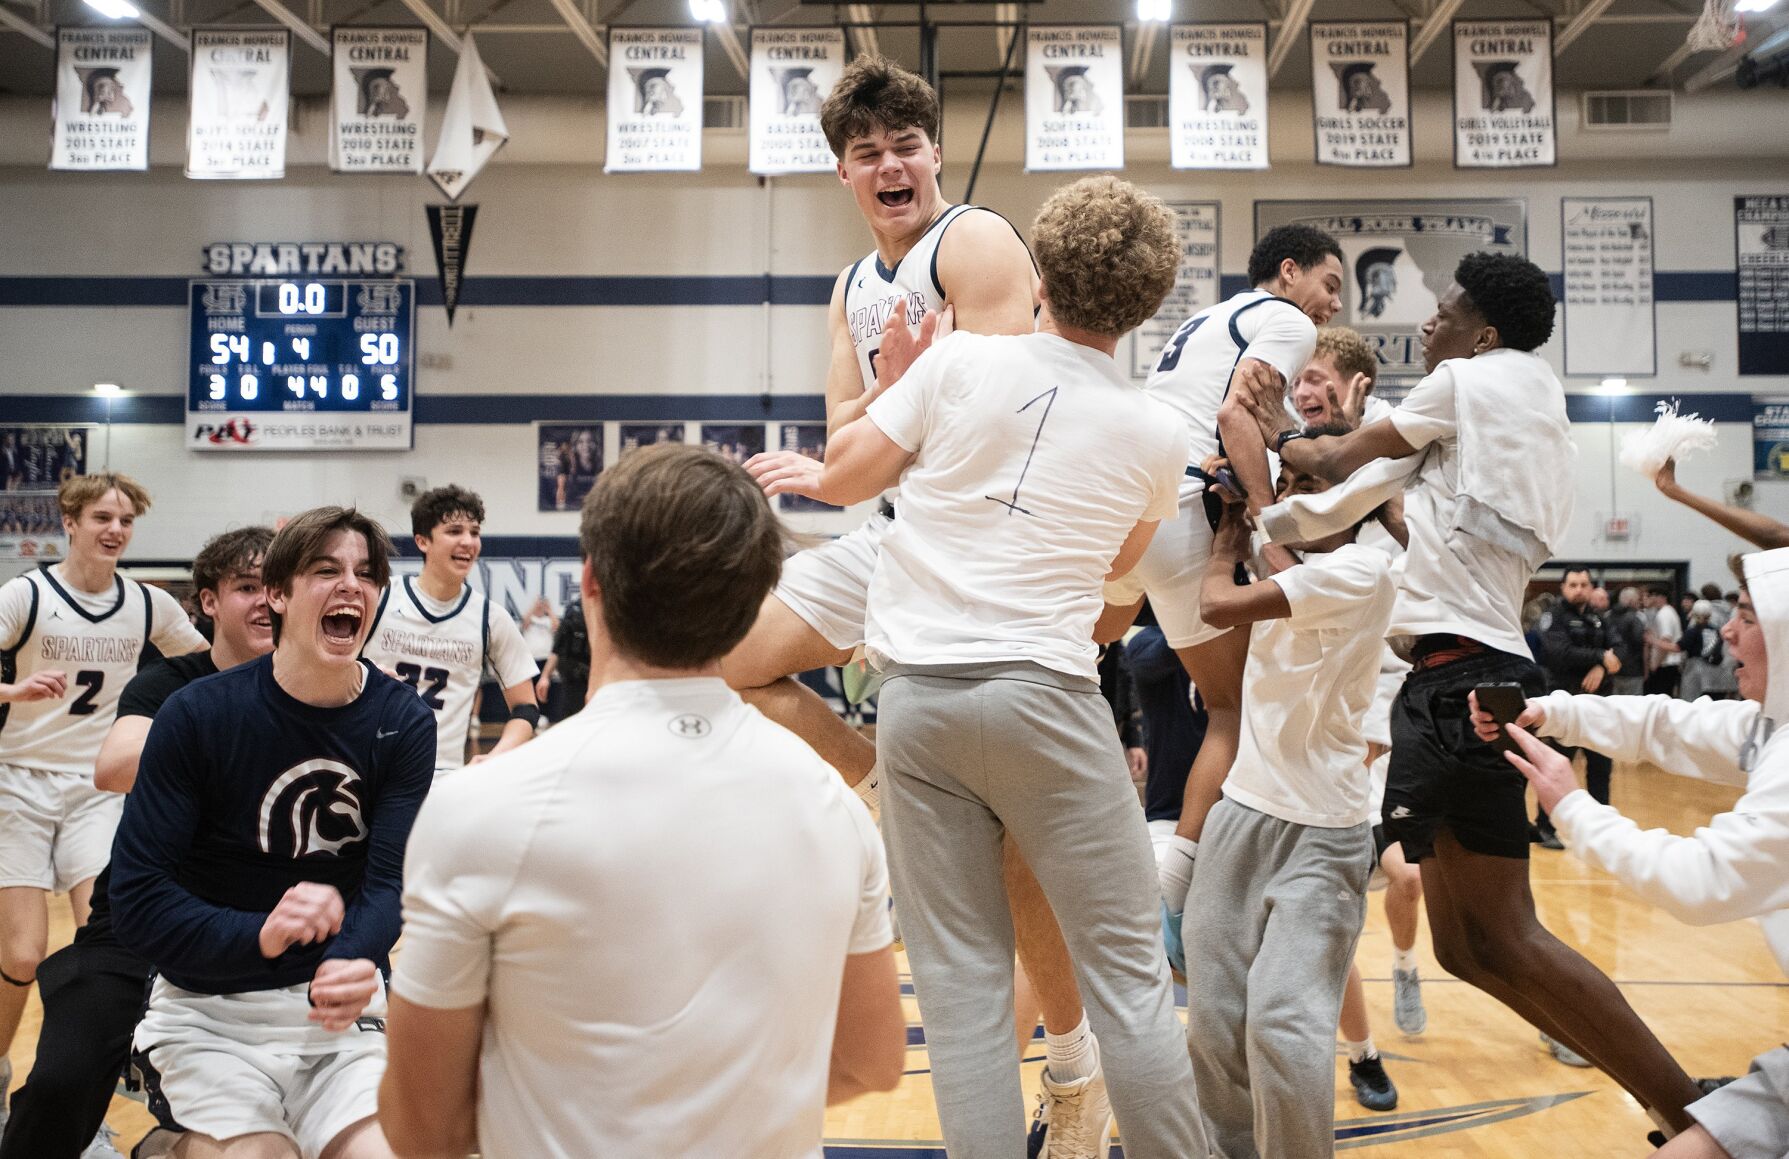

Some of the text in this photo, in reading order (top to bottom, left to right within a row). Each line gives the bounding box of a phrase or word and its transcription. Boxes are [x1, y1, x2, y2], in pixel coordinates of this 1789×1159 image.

[74, 47, 135, 60] CENTRAL
[349, 47, 410, 60] CENTRAL
[625, 46, 687, 60] CENTRAL
[768, 46, 828, 60] CENTRAL
[1043, 44, 1104, 57] CENTRAL
[1187, 42, 1249, 57] CENTRAL
[1328, 41, 1390, 55] CENTRAL
[1470, 40, 1534, 55] CENTRAL
[66, 122, 137, 134] WRESTLING
[341, 122, 416, 134] WRESTLING
[768, 123, 822, 134] BASEBAL
[1182, 119, 1258, 131] WRESTLING
[1358, 117, 1406, 128] SOCCER
[101, 138, 137, 149] STATE
[377, 138, 415, 149] STATE
[799, 139, 828, 149] STA
[1221, 137, 1258, 146] STATE
[1361, 133, 1400, 144] STATE
[1502, 133, 1543, 144] STATE
[239, 141, 275, 151] STATE
[95, 153, 131, 163] PLACE
[371, 154, 411, 164] PLACE
[647, 153, 685, 163] PLACE
[792, 154, 831, 164] PLACE
[1068, 152, 1106, 161] PLACE
[1214, 151, 1252, 161] PLACE
[1355, 149, 1394, 160] PLACE
[1497, 148, 1539, 160] PLACE
[232, 157, 270, 166] PLACE
[208, 243, 400, 275] SPARTANS
[278, 283, 326, 314] 0.0
[208, 317, 246, 332] HOME
[354, 317, 396, 332] GUEST
[210, 333, 250, 365] 54
[292, 338, 310, 360] 4
[360, 333, 399, 365] 50
[1157, 315, 1210, 372] 3
[210, 374, 226, 400] 3
[240, 374, 258, 400] 0
[341, 374, 359, 400] 0
[264, 424, 316, 438] PEOPLES
[319, 424, 349, 438] BANK
[367, 424, 402, 438] TRUST
[41, 636, 139, 662] SPARTANS
[381, 628, 474, 664] SPARTANS
[68, 670, 105, 715] 2
